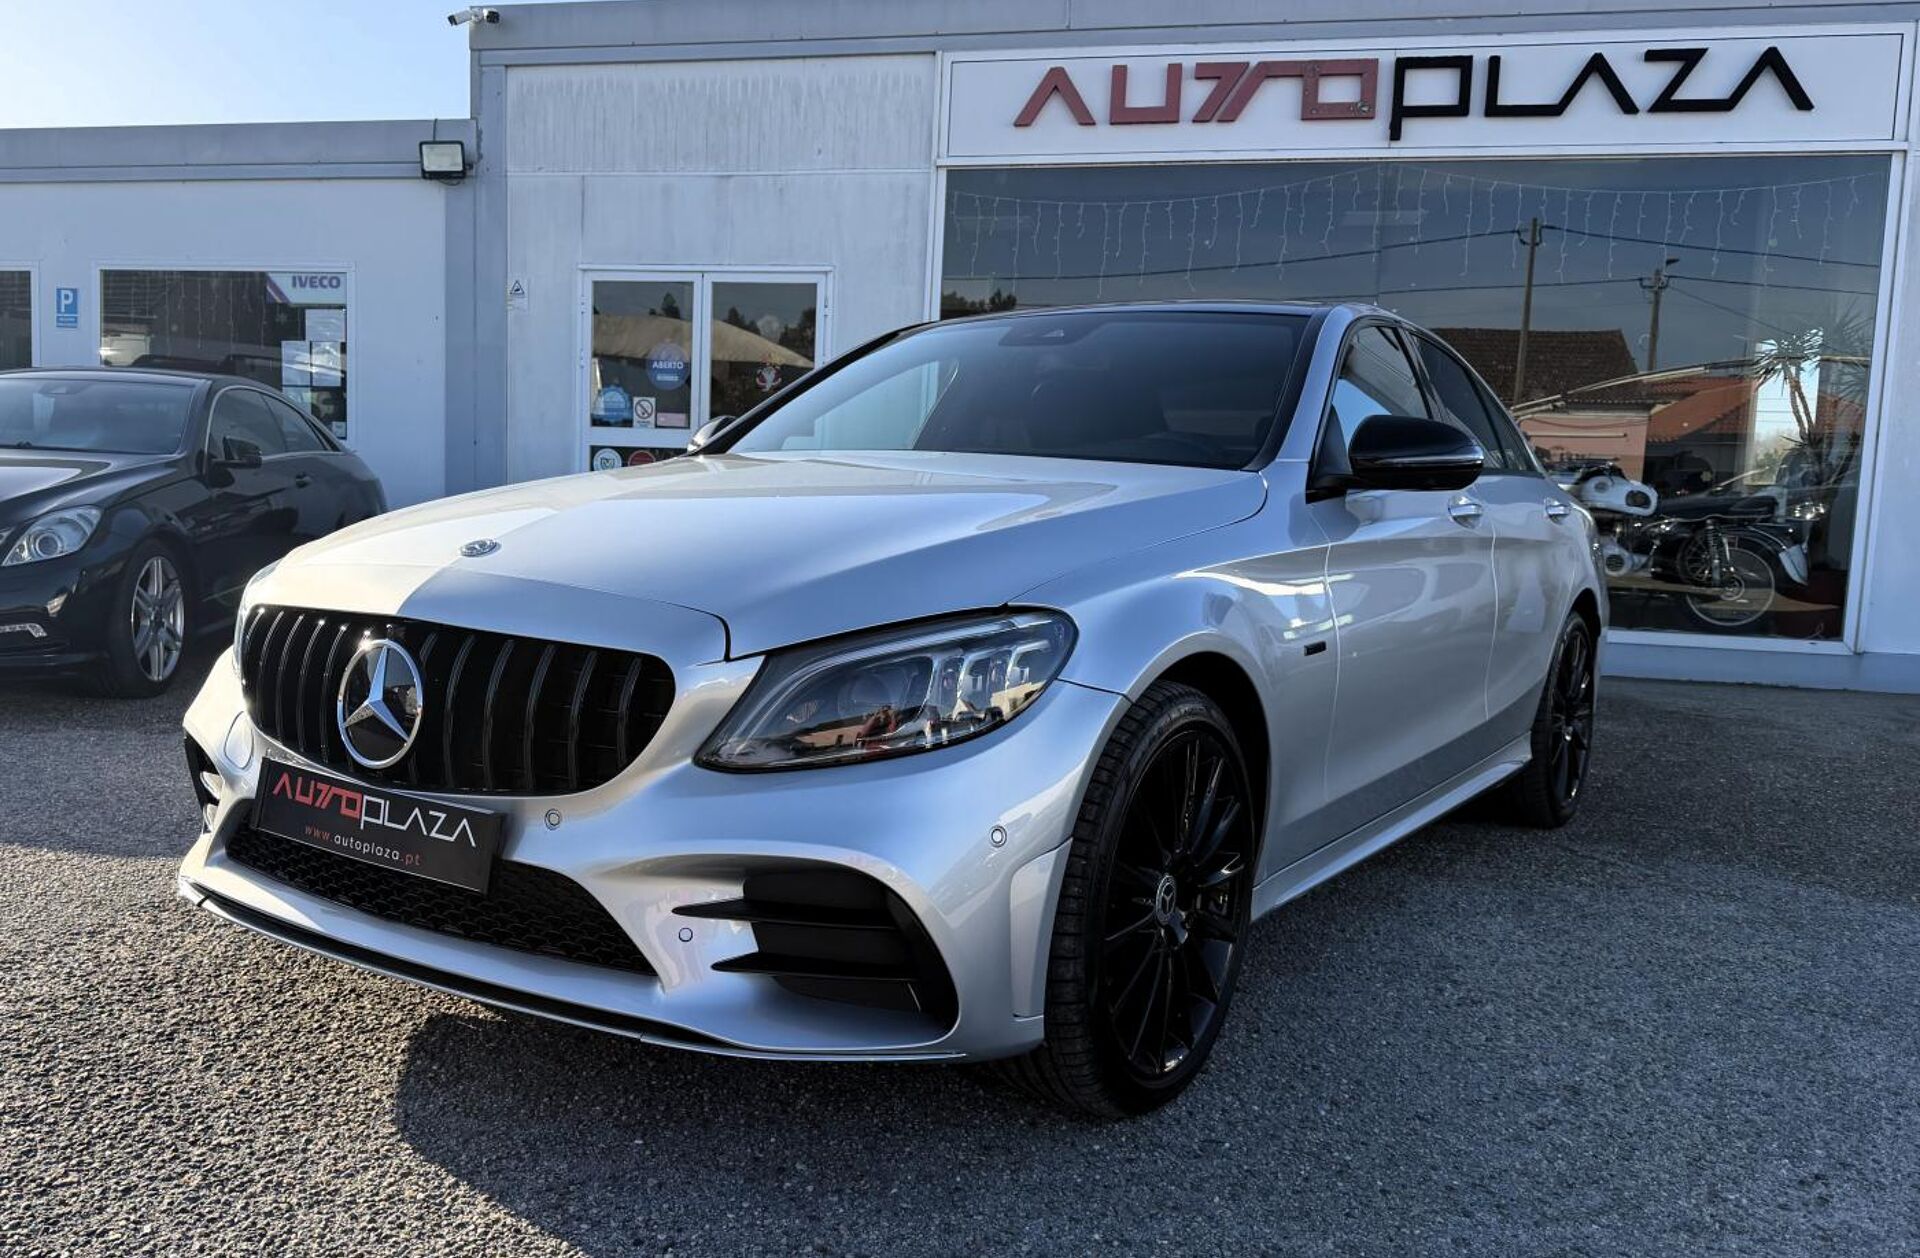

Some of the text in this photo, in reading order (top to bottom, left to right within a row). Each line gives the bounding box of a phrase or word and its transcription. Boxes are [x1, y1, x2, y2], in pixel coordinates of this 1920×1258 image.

[291, 275, 341, 289] IVECO
[61, 289, 74, 313] P
[652, 361, 684, 370] ABERTO
[304, 824, 422, 867] www.autoplaza.pt
